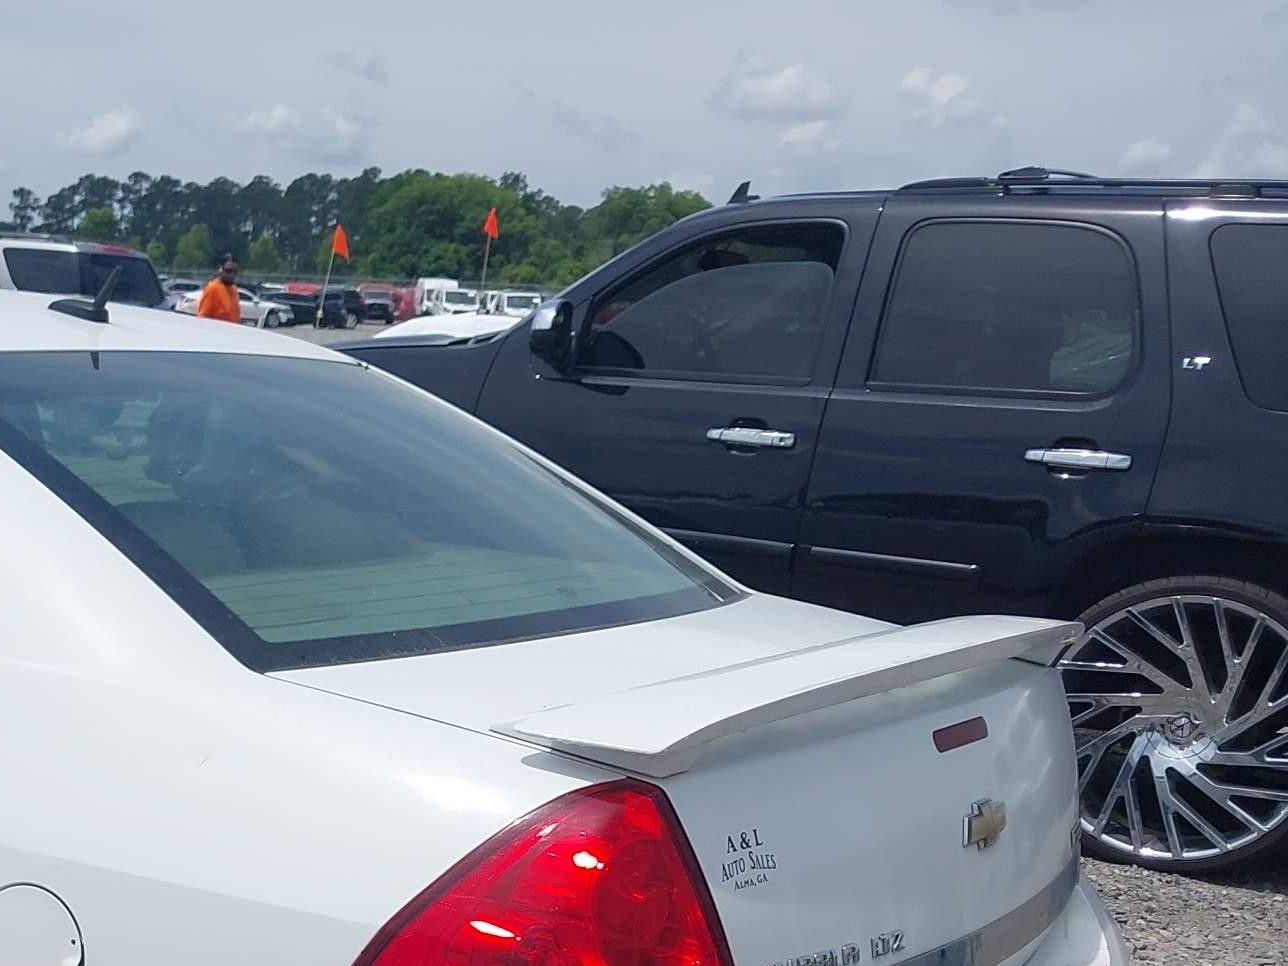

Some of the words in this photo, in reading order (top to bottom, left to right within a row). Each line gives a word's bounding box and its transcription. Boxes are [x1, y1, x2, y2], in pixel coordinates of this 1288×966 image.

[1182, 357, 1212, 370] LT
[727, 835, 738, 854] A
[740, 831, 752, 850] &
[753, 829, 764, 847] L
[722, 857, 746, 883] AUTO
[748, 850, 777, 870] SALES
